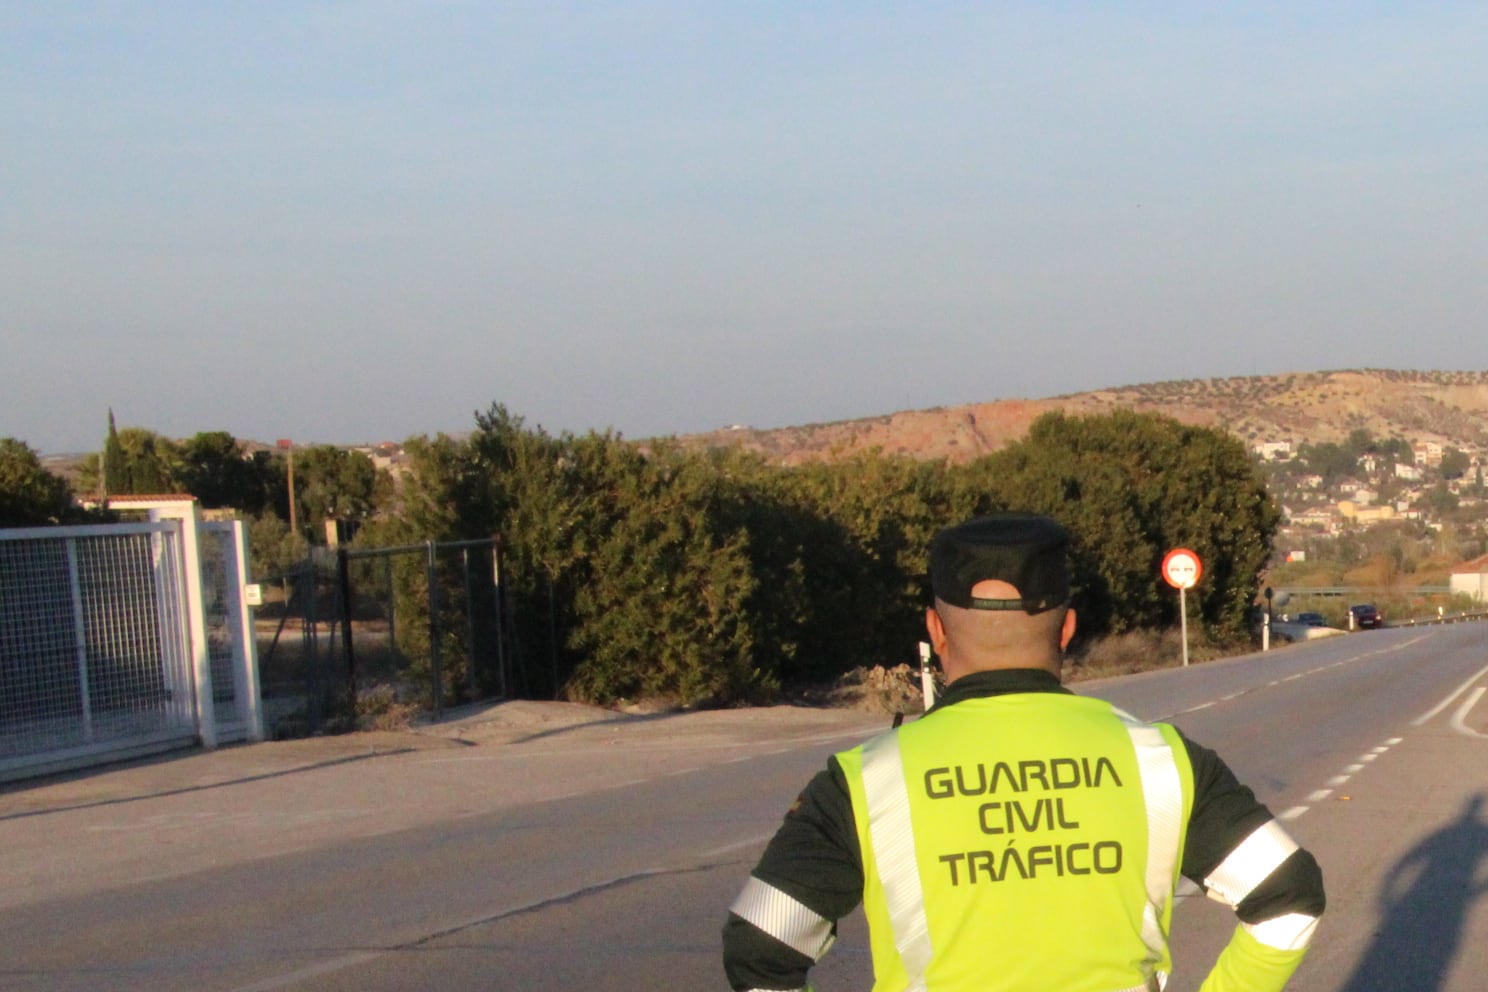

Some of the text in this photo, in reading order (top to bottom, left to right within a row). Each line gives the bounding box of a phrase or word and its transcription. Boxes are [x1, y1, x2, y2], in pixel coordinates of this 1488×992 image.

[924, 756, 1123, 799] GUARDIA
[978, 797, 1080, 835] CIVIL
[938, 839, 1123, 887] TRÁFICO
